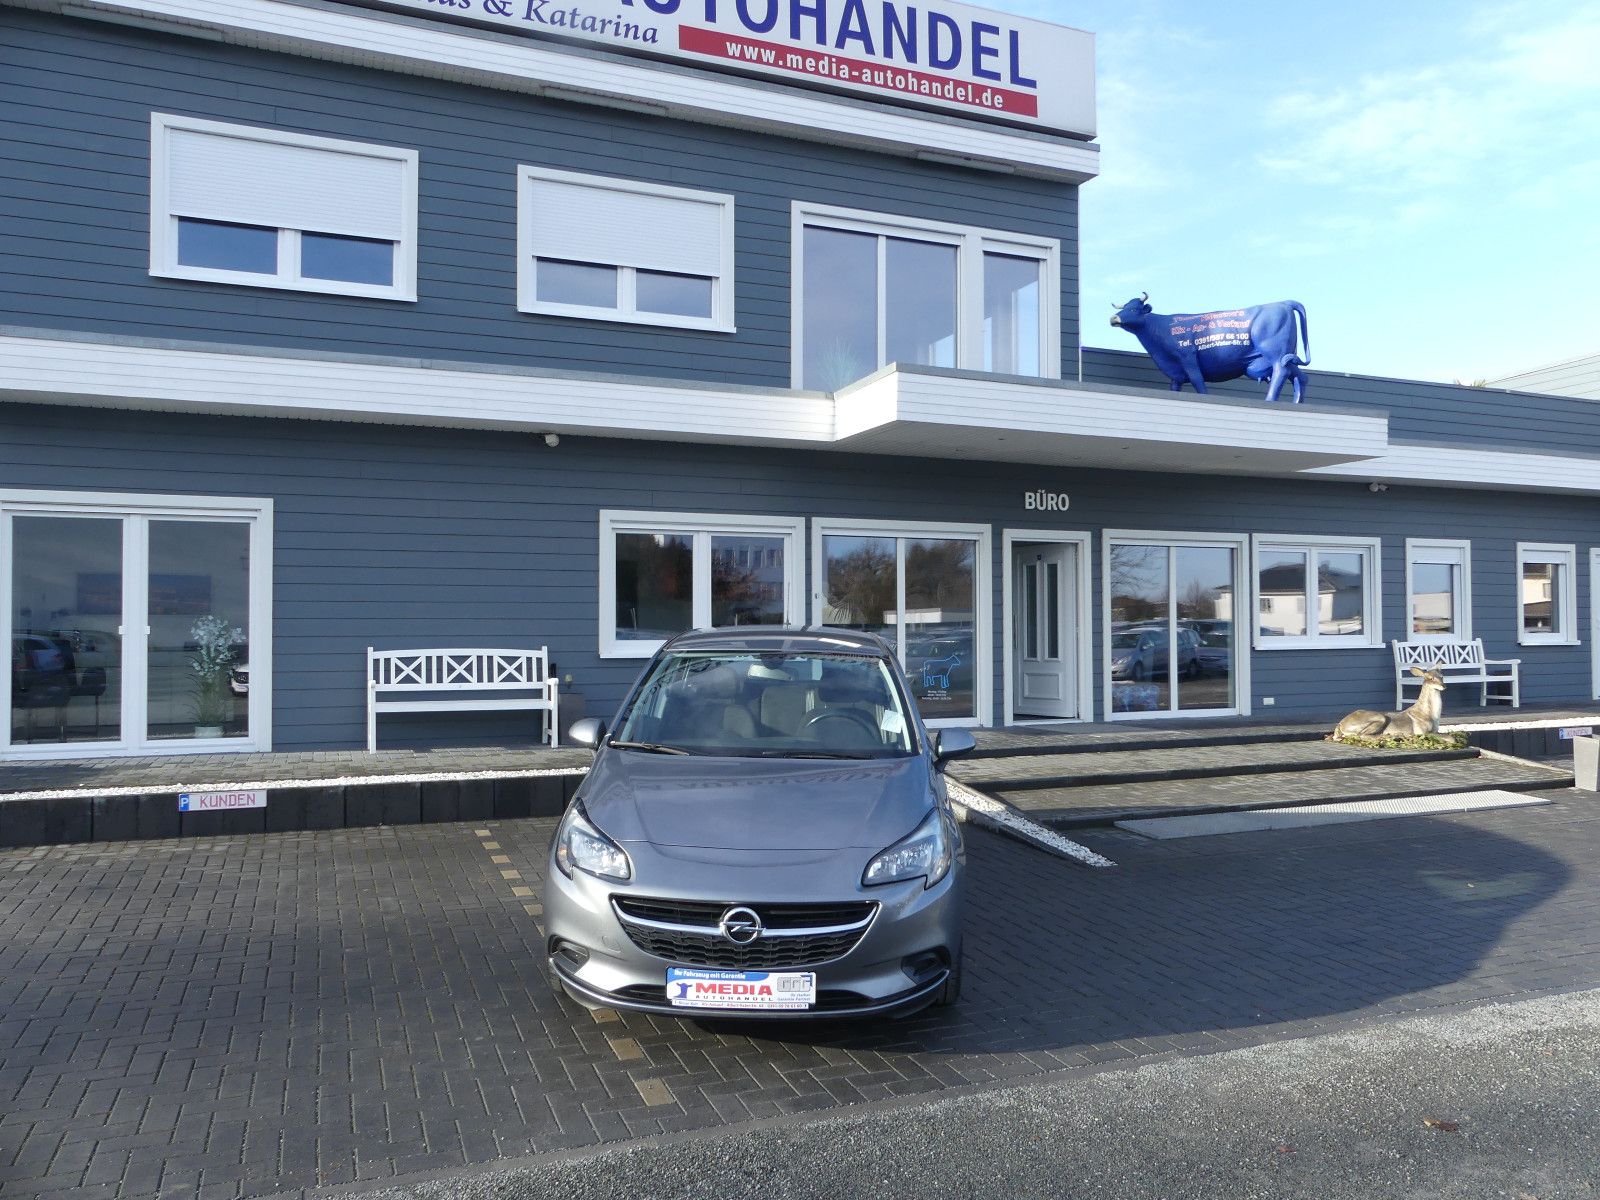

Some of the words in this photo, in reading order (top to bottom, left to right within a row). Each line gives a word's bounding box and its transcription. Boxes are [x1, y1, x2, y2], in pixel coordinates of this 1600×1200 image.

[522, 0, 659, 44] Katarina
[621, 0, 1037, 89] OHANDEL
[725, 41, 1004, 109] www.media-autohandel.de
[1178, 339, 1192, 347] Tel.
[1024, 489, 1070, 511] BÜRO
[181, 797, 189, 808] P
[200, 793, 256, 808] KUNDEN
[683, 970, 710, 979] Fahrzeug
[695, 982, 773, 996] MEDIA
